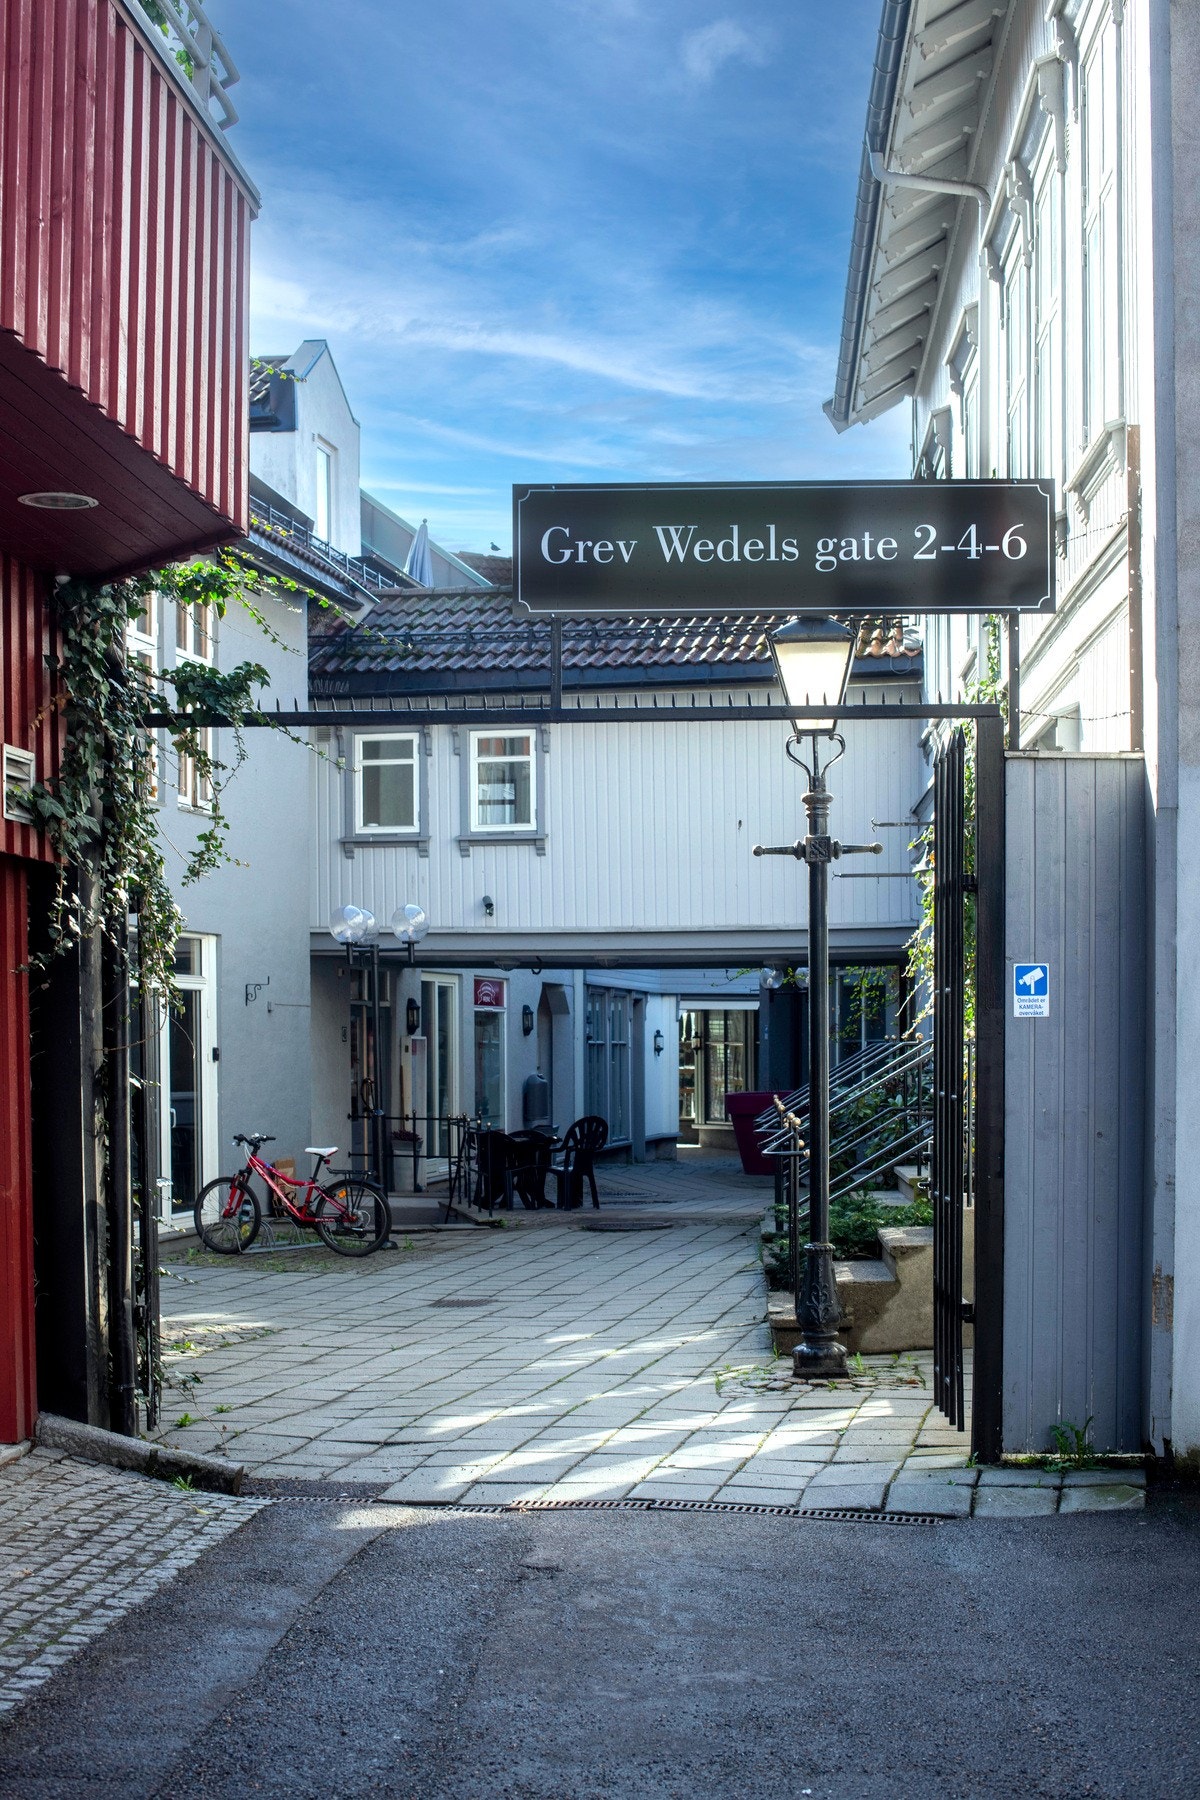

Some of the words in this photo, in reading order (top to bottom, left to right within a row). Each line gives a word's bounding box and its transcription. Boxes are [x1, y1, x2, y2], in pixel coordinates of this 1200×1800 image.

[541, 526, 638, 564] Grev
[652, 524, 800, 563] Wedels
[814, 531, 899, 572] gate
[912, 523, 1028, 560] 2-4-6
